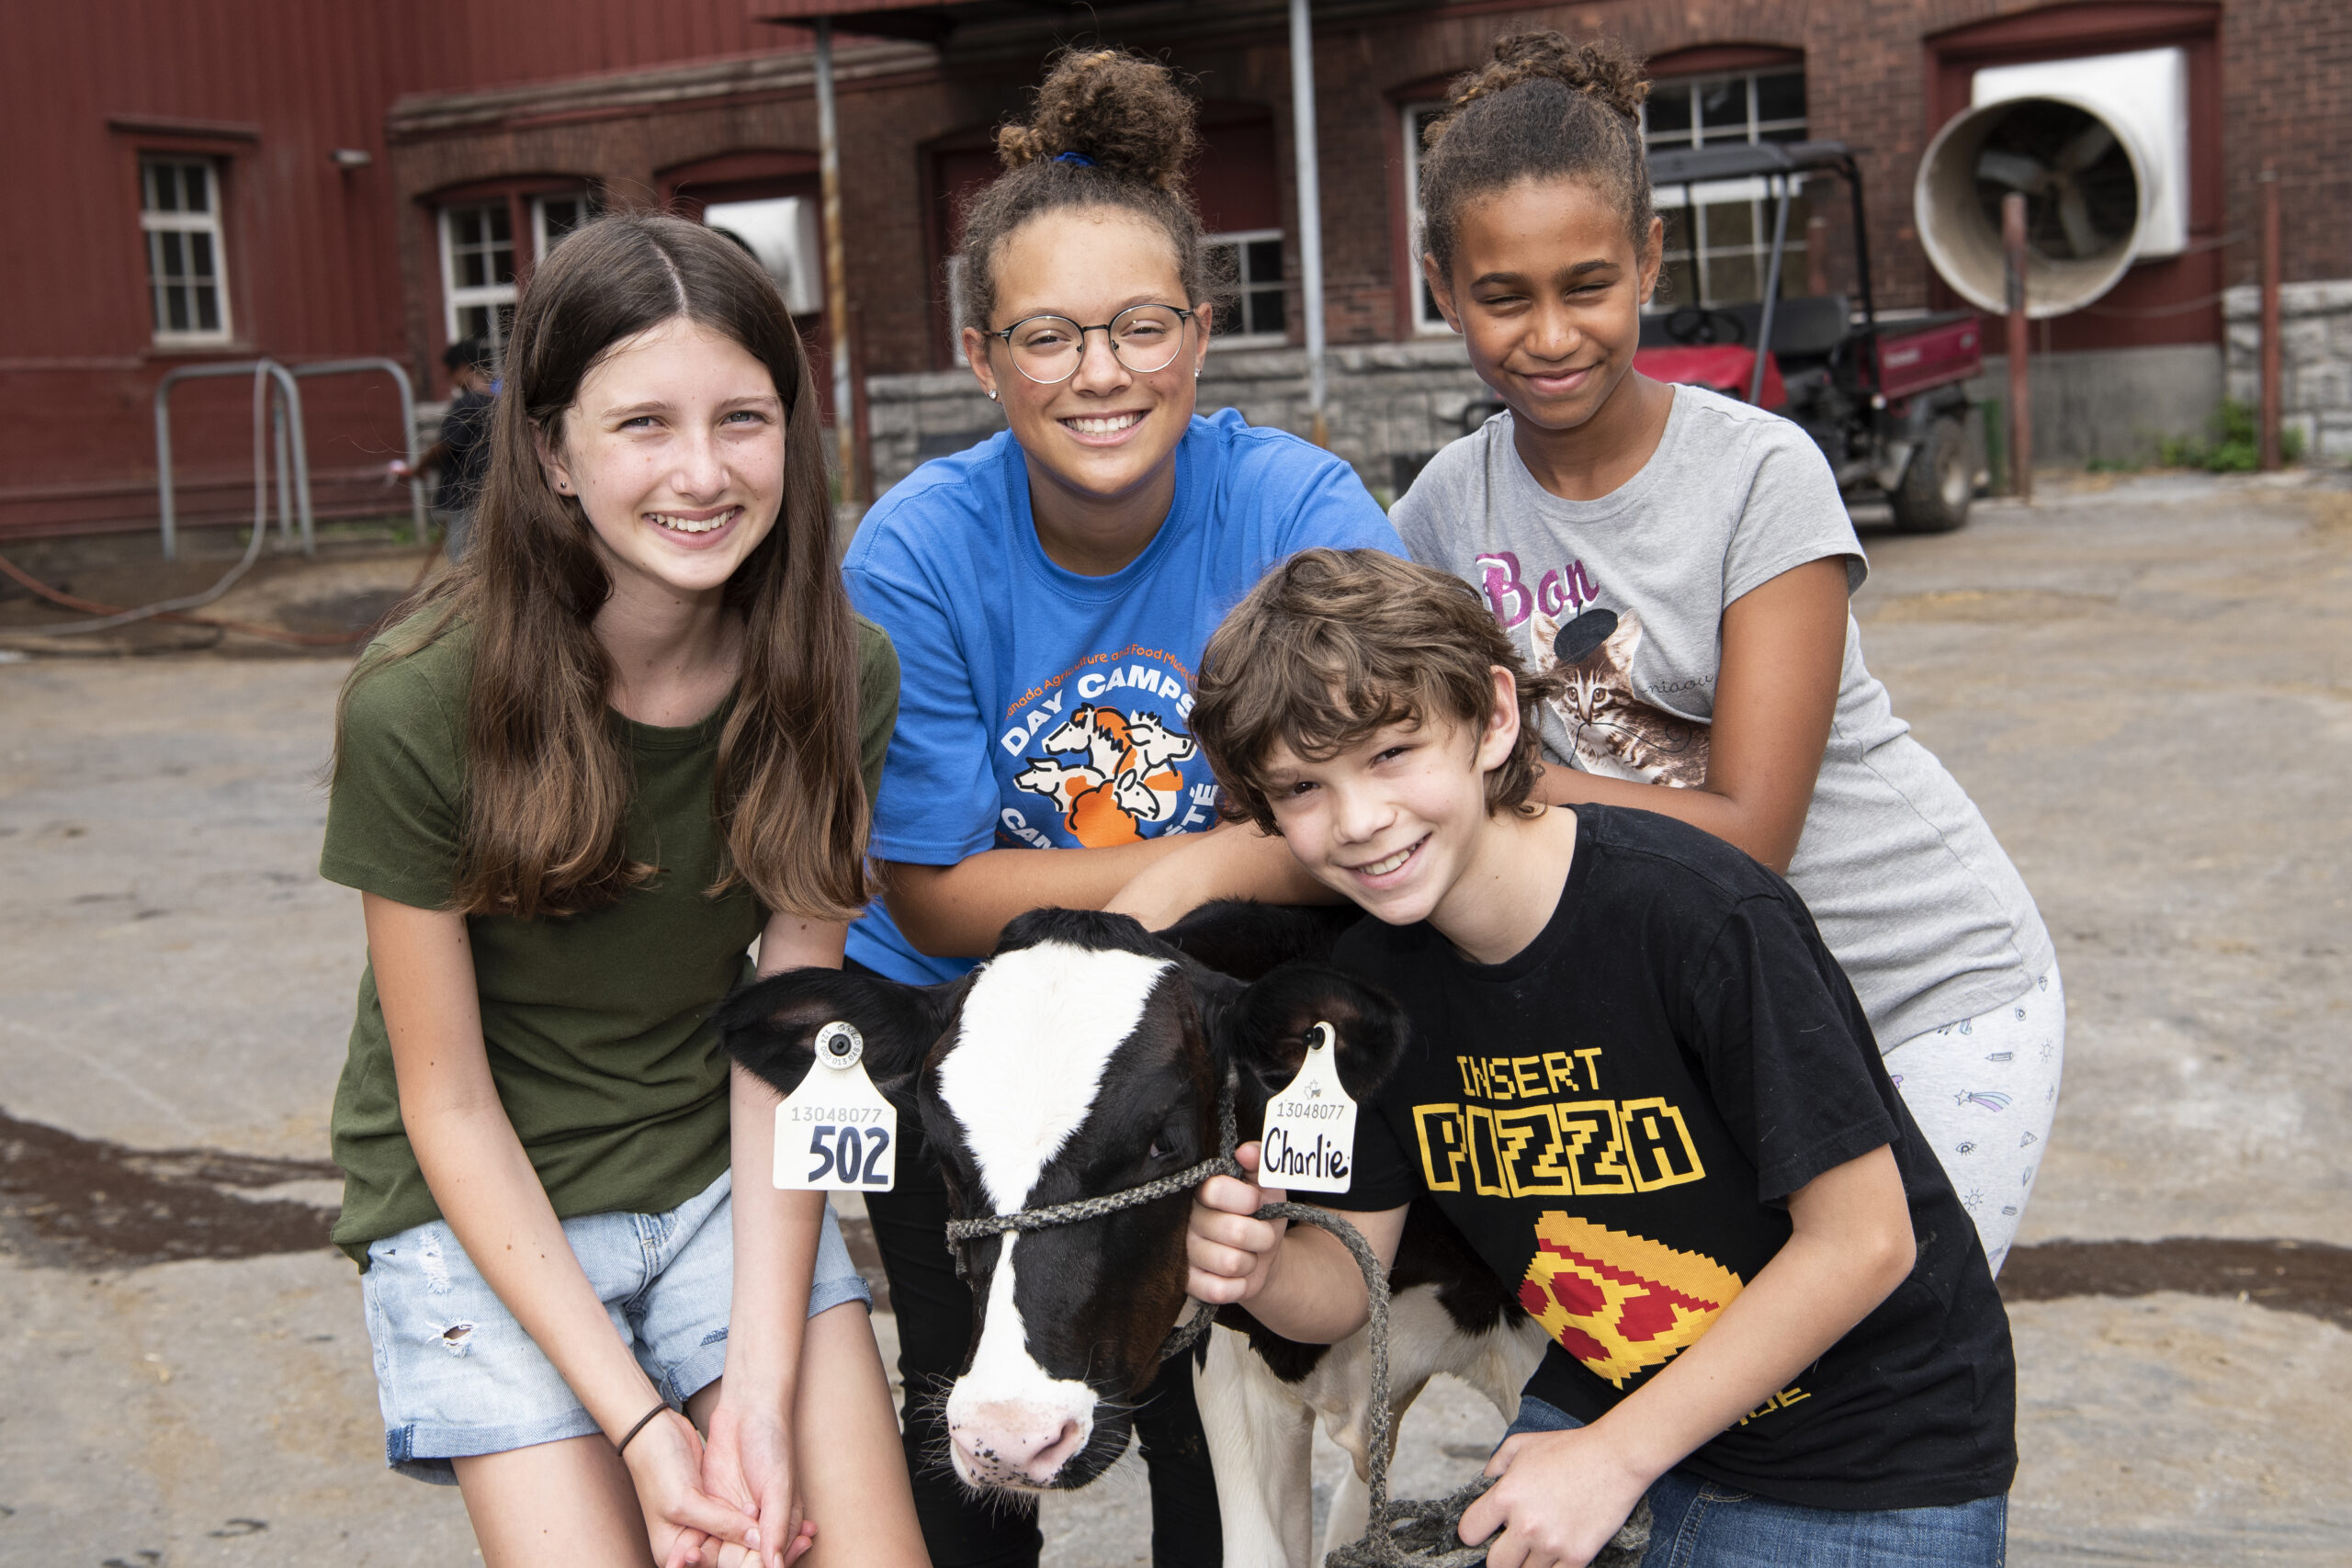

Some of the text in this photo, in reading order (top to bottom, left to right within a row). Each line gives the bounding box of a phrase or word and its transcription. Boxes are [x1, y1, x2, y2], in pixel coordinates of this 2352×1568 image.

[1476, 551, 1600, 632] Bon
[1111, 644, 1130, 660] and
[1130, 644, 1163, 660] Food
[1001, 664, 1197, 757] DAY CAMPS
[1457, 1047, 1602, 1100] INSERT
[791, 1106, 883, 1122] 13048077
[1276, 1102, 1345, 1120] 13048077
[808, 1125, 889, 1185] 502
[1264, 1126, 1349, 1179] Charlie
[1412, 1097, 1706, 1198] PIZZA
